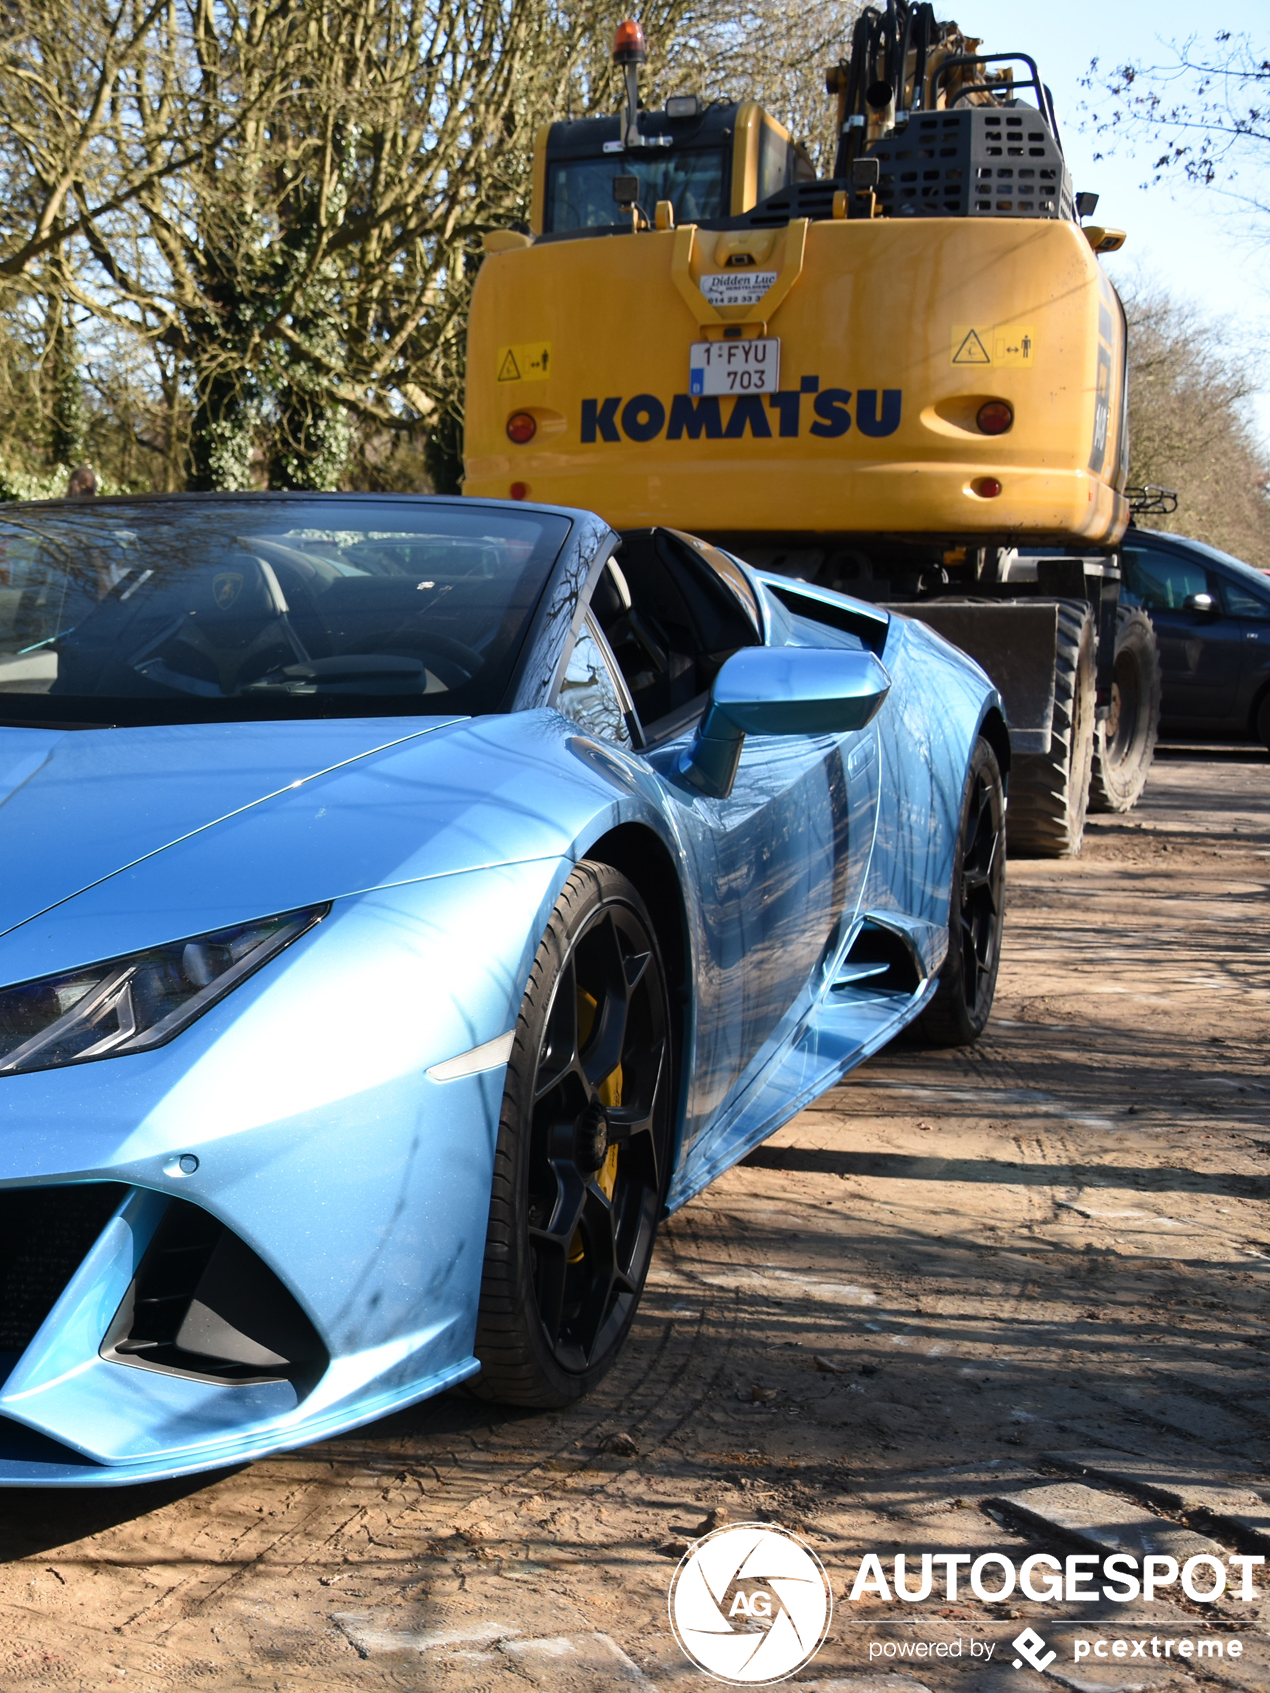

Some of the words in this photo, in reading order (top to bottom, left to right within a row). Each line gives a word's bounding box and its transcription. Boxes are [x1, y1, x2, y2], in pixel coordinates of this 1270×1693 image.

[711, 275, 750, 287] Didden
[755, 274, 775, 285] Luc
[727, 370, 765, 390] 703
[581, 375, 902, 443] KOMATSU
